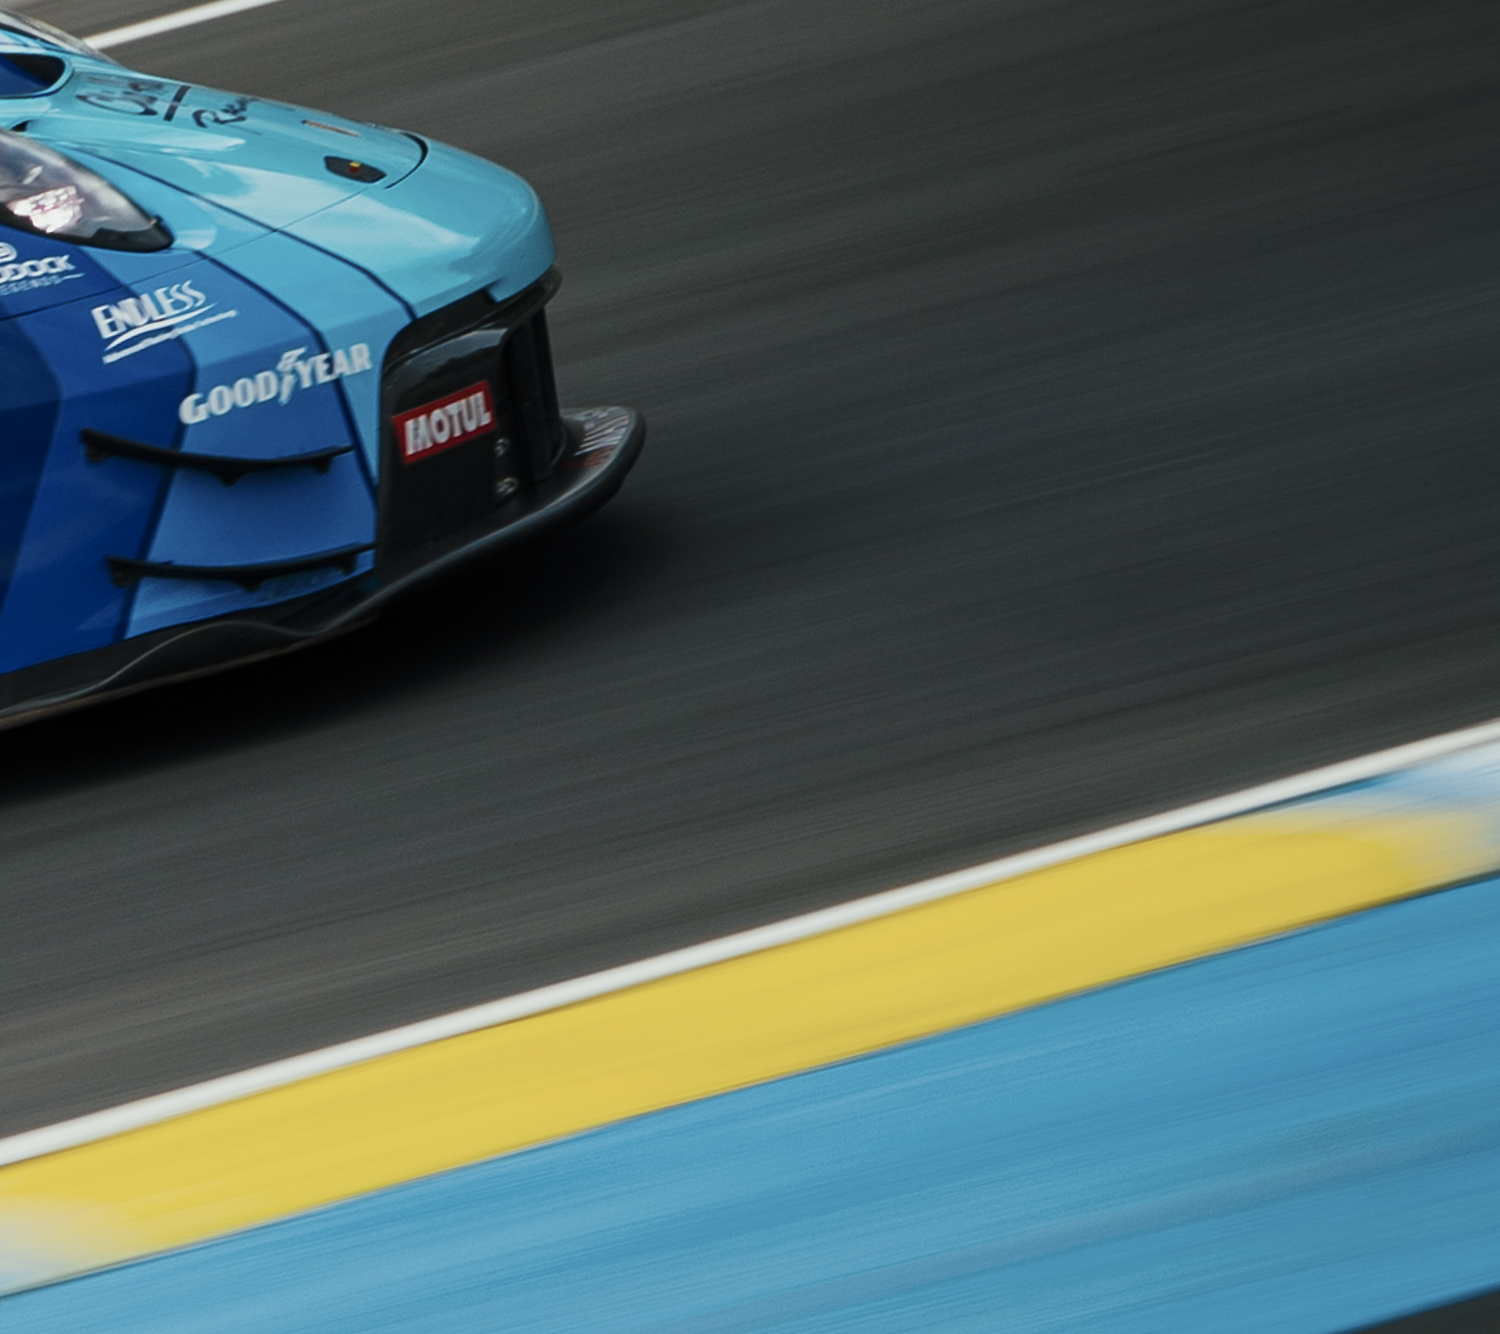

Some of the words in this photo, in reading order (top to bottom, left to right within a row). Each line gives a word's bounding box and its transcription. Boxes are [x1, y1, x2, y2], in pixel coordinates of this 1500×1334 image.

[91, 280, 206, 339] ENDLESS
[179, 343, 372, 424] GOODYEAR
[404, 390, 492, 456] MOTUL
